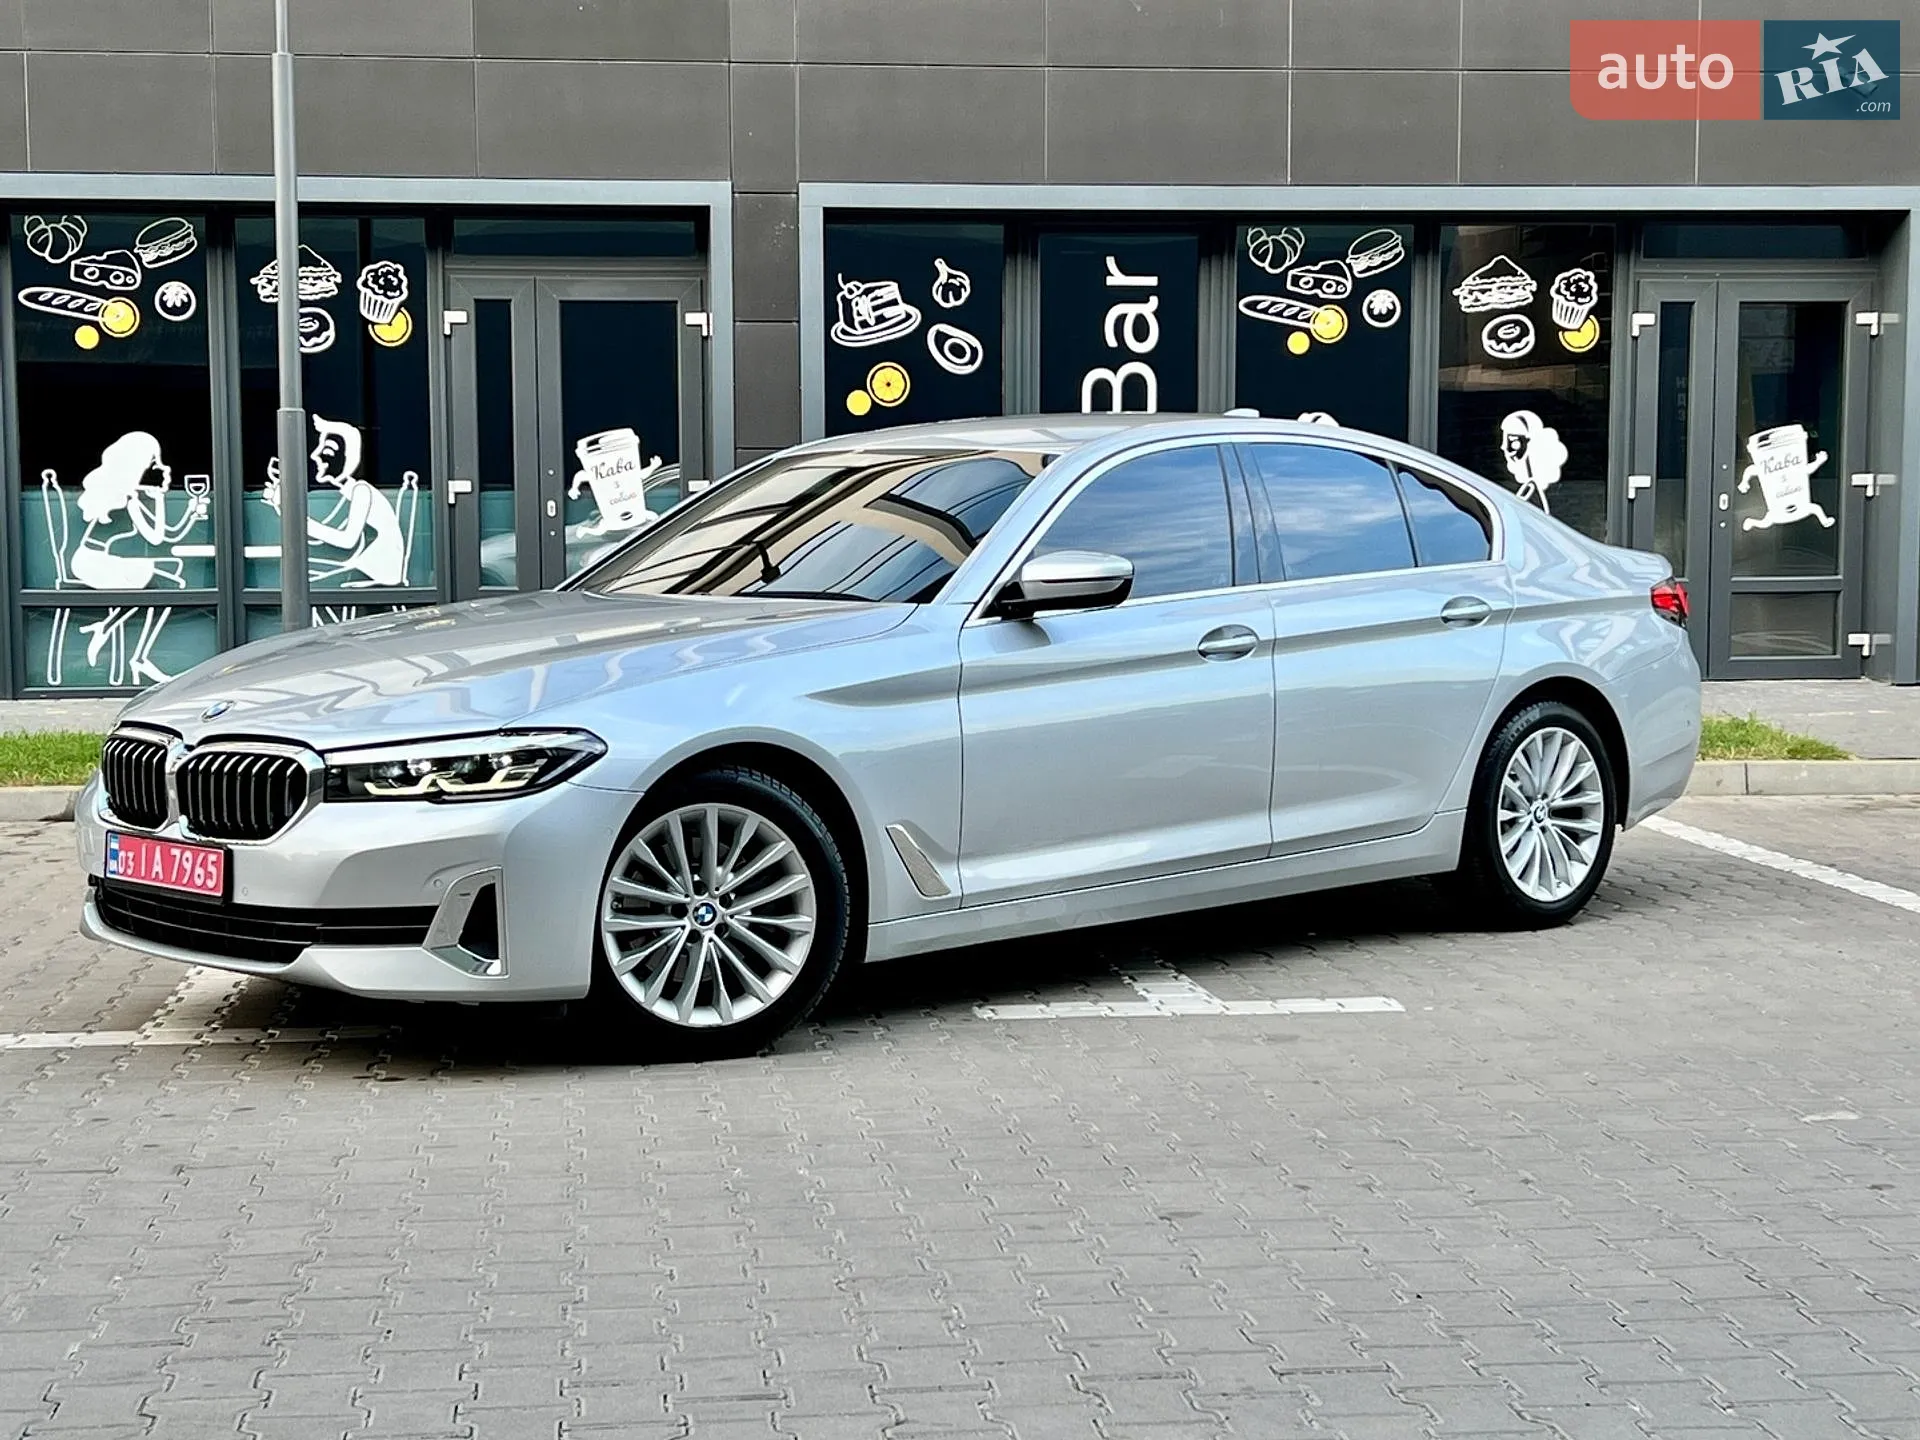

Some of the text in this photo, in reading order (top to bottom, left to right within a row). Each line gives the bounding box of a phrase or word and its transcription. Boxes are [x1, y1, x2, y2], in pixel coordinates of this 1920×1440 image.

[1081, 256, 1159, 414] Bar
[591, 457, 636, 480] Кава
[118, 843, 218, 889] 03 IA 7965
